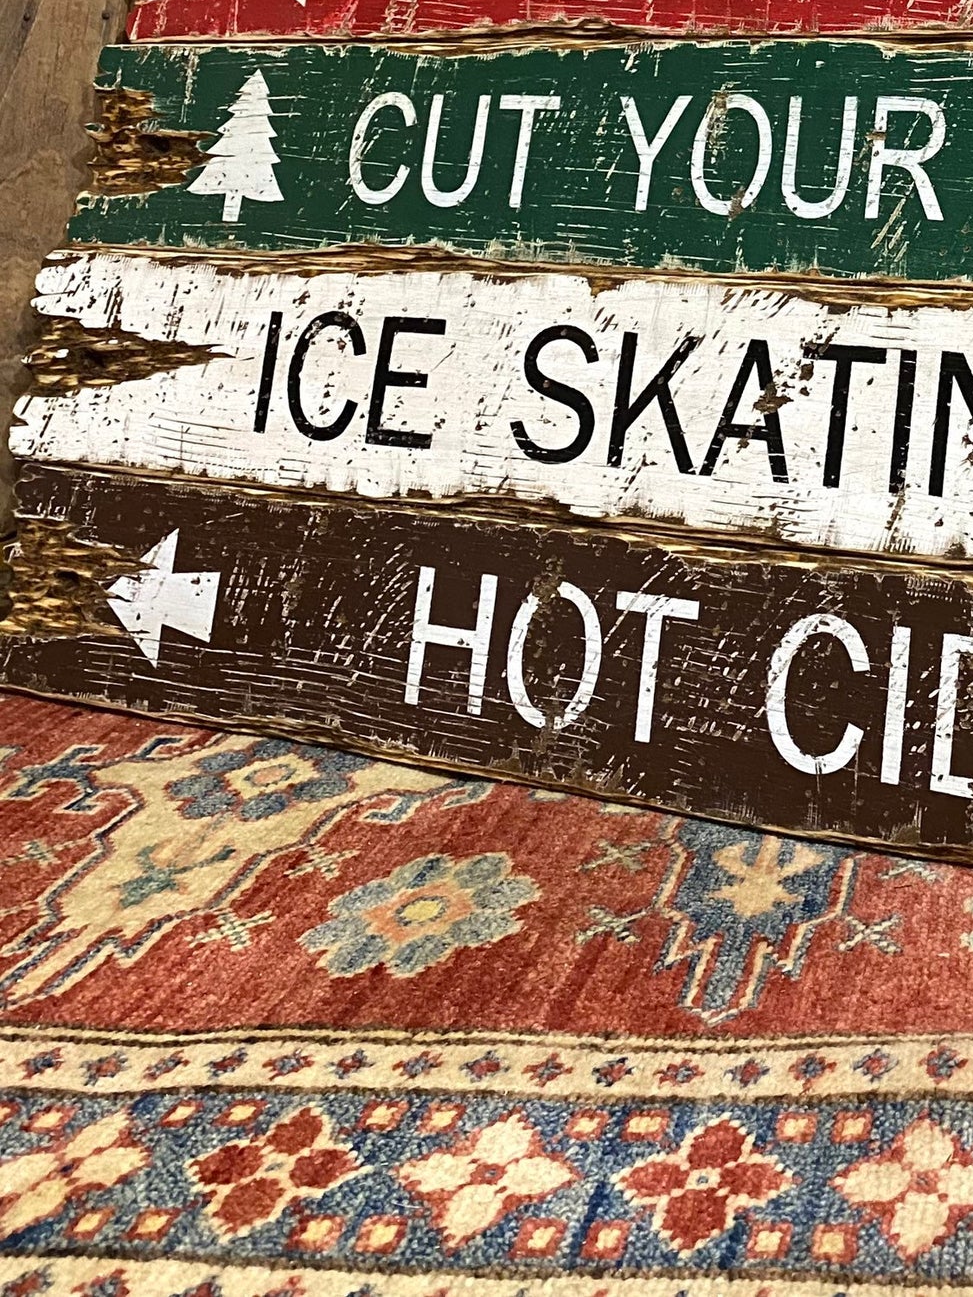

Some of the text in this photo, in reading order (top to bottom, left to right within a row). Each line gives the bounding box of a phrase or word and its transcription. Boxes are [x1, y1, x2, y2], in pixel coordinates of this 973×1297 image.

[349, 91, 560, 208] CUT
[619, 94, 945, 222] YOUR
[253, 310, 447, 450] ICE
[404, 565, 700, 744] HOT
